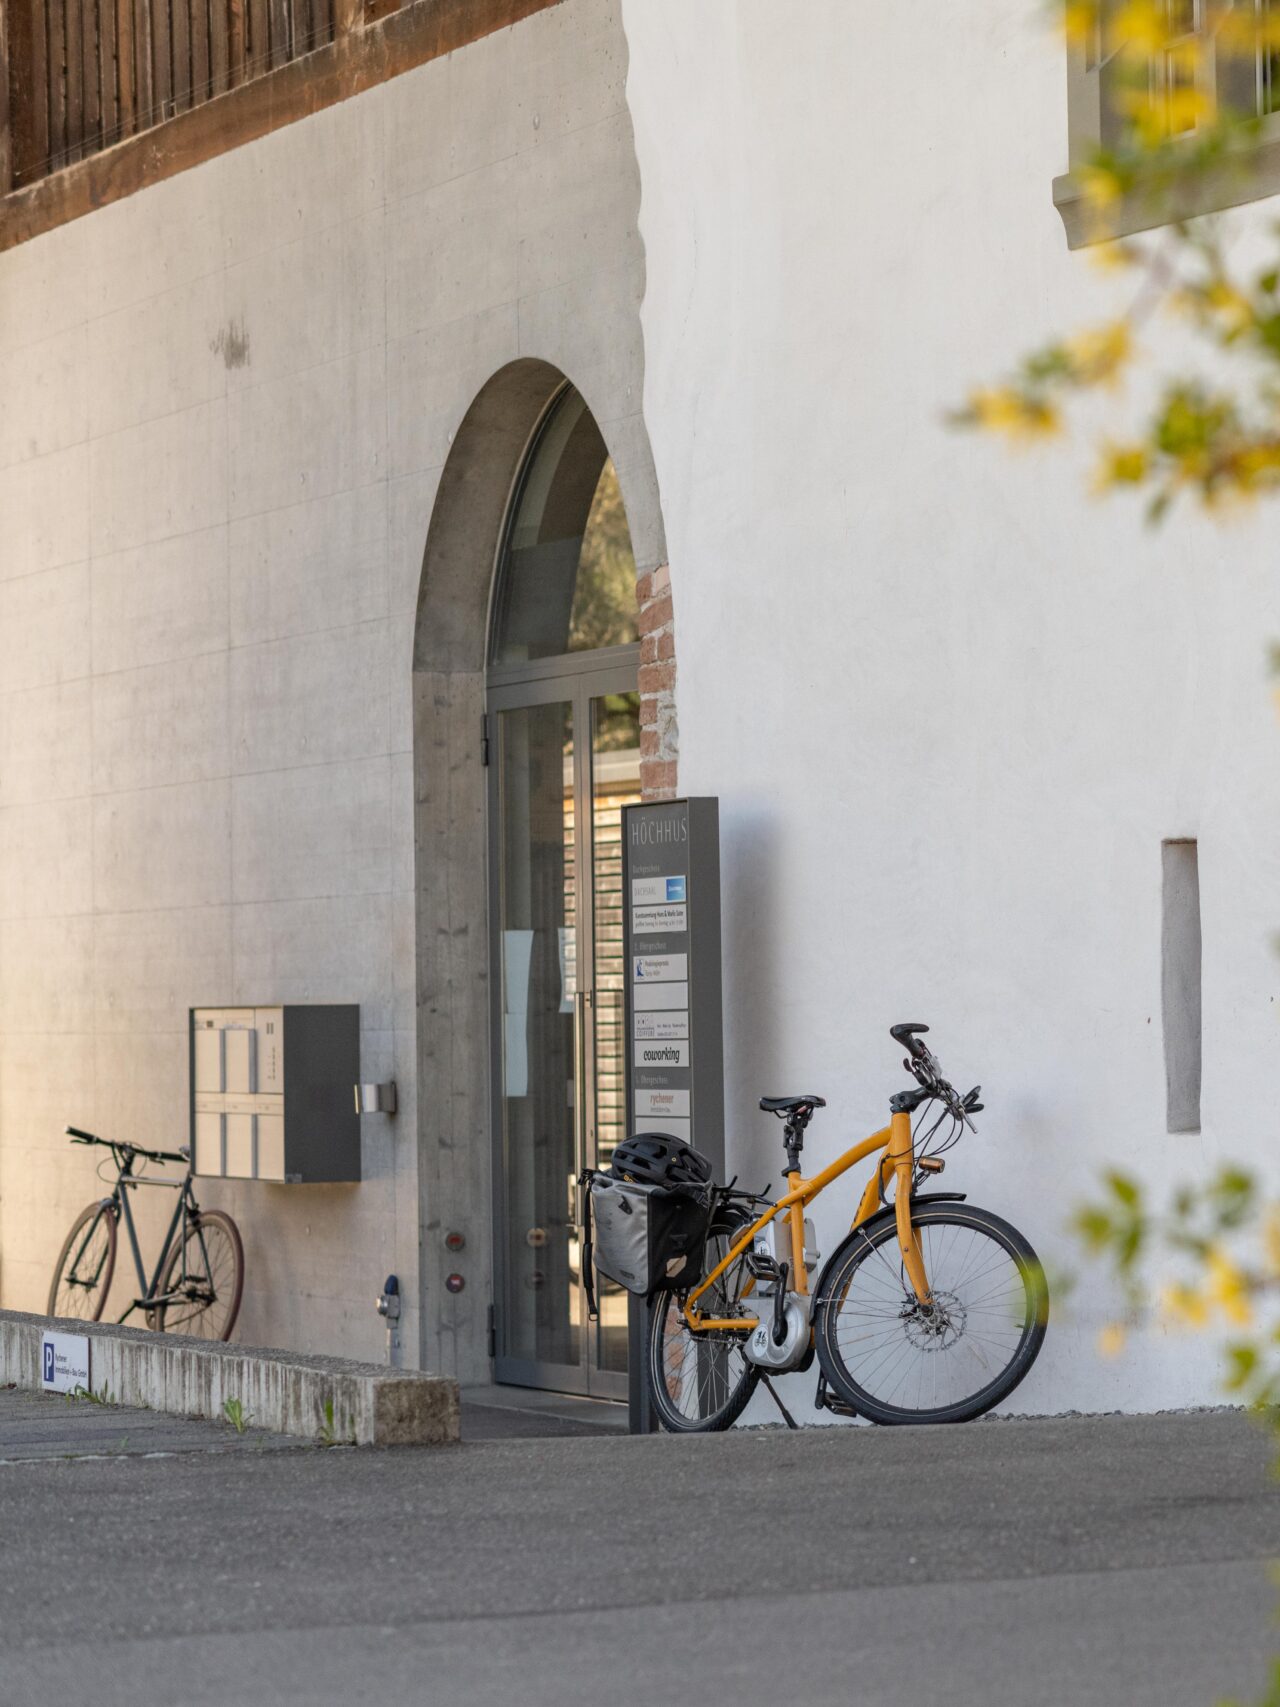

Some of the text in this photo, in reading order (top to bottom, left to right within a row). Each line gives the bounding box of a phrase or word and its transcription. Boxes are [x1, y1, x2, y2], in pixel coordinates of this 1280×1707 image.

[632, 816, 687, 846] HÖCHHUS
[643, 1046, 680, 1064] coworking
[650, 1092, 673, 1106] rychener
[46, 1346, 53, 1380] P
